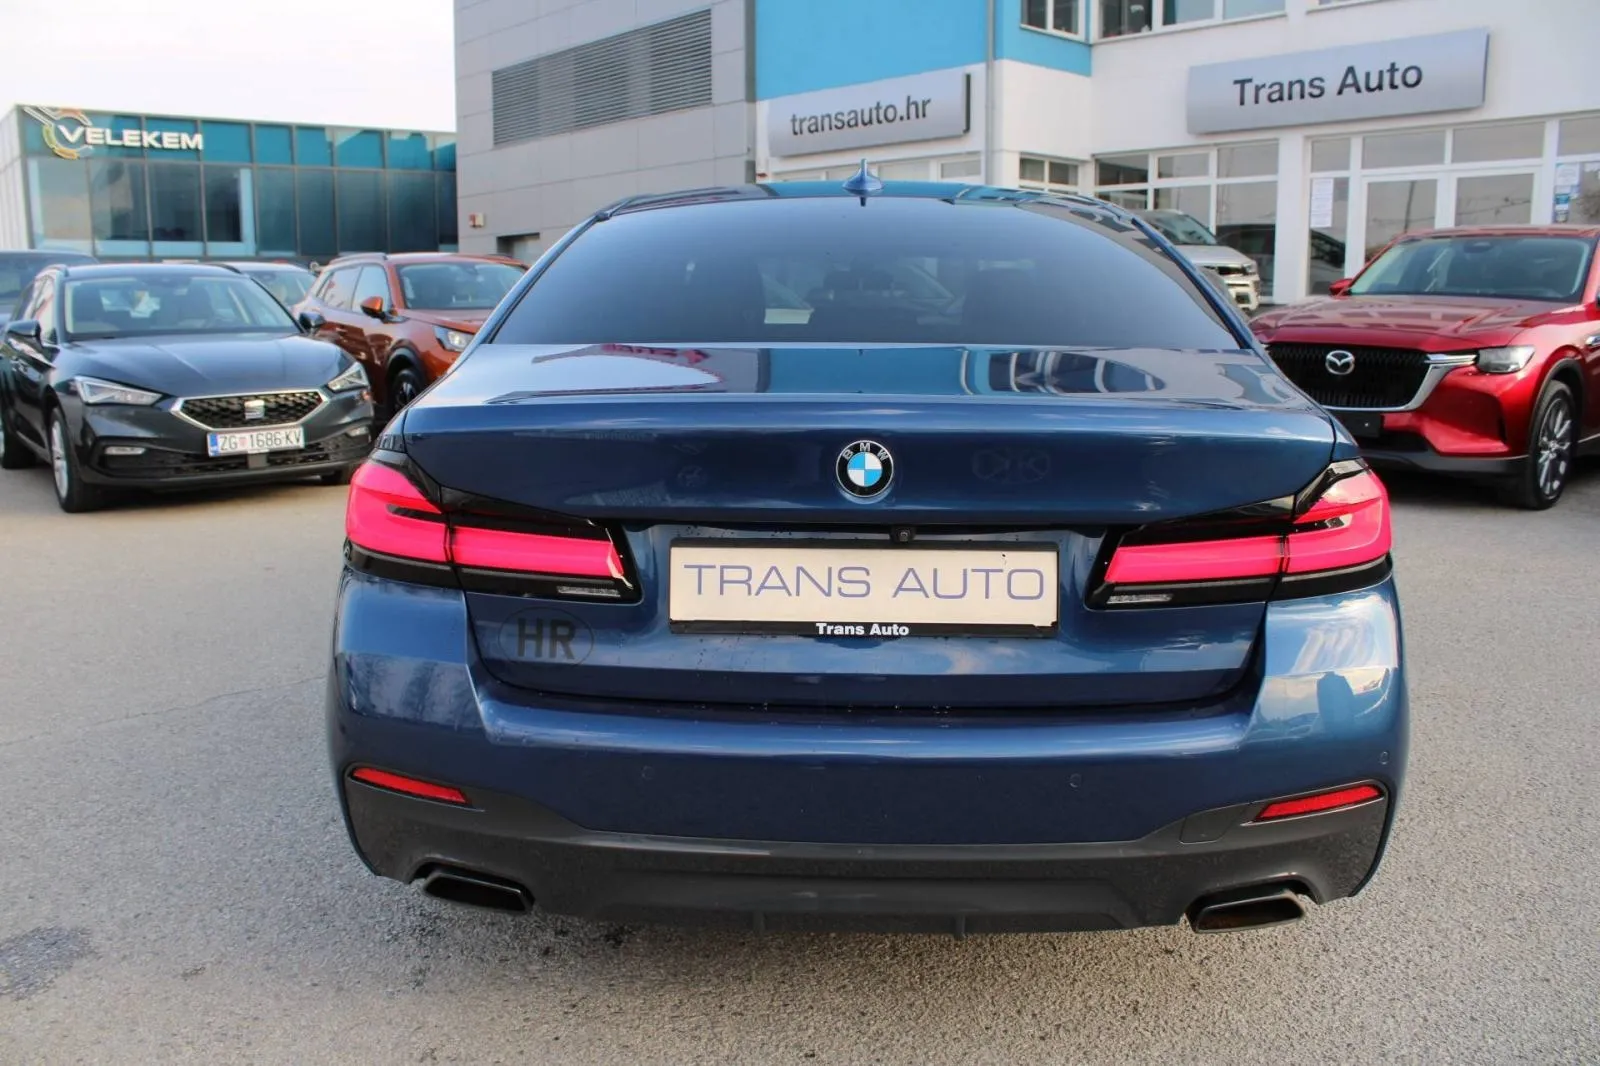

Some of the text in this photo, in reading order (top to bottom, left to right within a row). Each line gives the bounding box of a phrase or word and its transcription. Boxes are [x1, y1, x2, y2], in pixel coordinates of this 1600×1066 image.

[1233, 62, 1423, 107] Trans Auto
[790, 95, 931, 136] transauto.hr
[57, 124, 203, 150] VELEKEM
[219, 429, 301, 451] ZG 1686 KV
[842, 442, 889, 462] BMW
[683, 563, 1045, 601] TRANS AUTO
[516, 617, 577, 660] HR
[815, 622, 910, 636] Trans Auto
